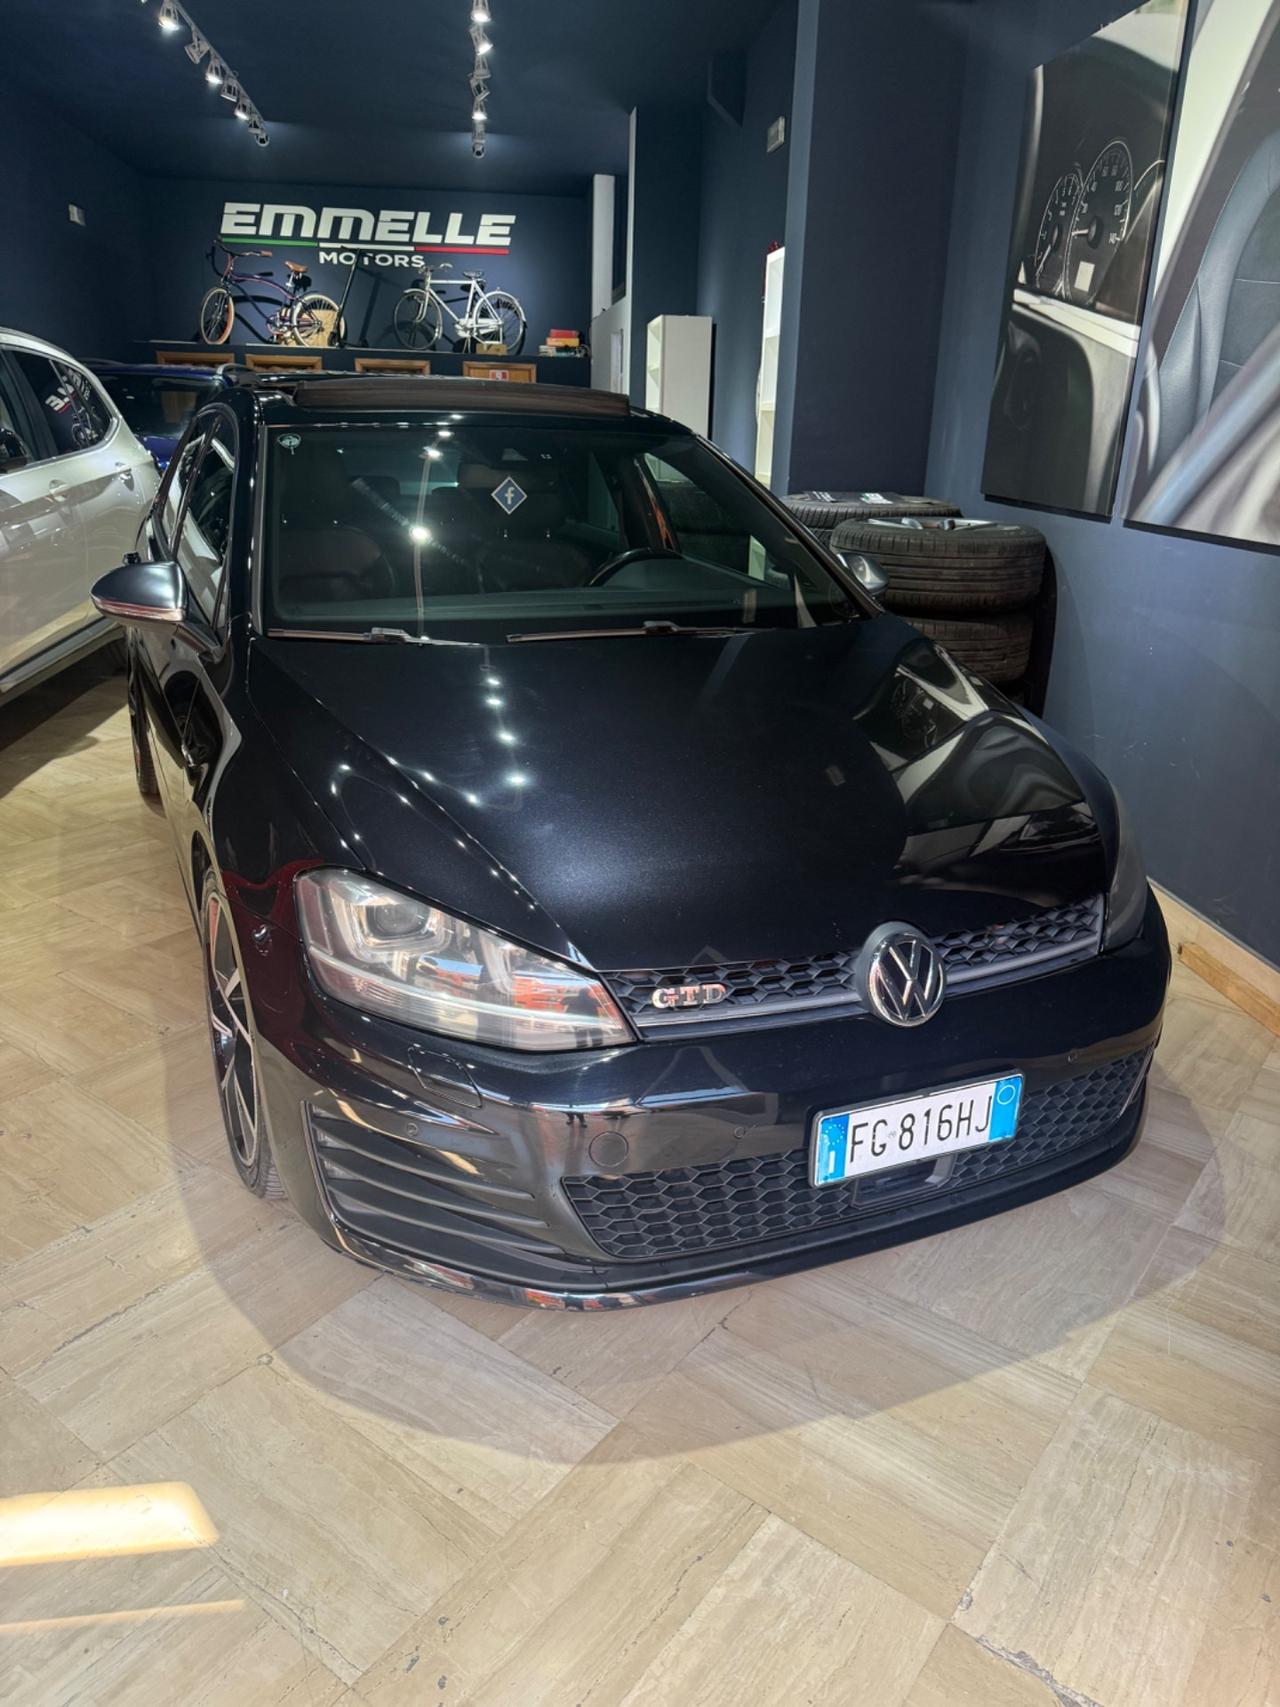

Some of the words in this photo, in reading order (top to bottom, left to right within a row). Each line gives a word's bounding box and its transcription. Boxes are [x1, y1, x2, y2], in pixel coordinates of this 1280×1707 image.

[220, 202, 516, 246] EMMELLE
[319, 251, 426, 268] MOTORS
[652, 983, 727, 1009] GTD
